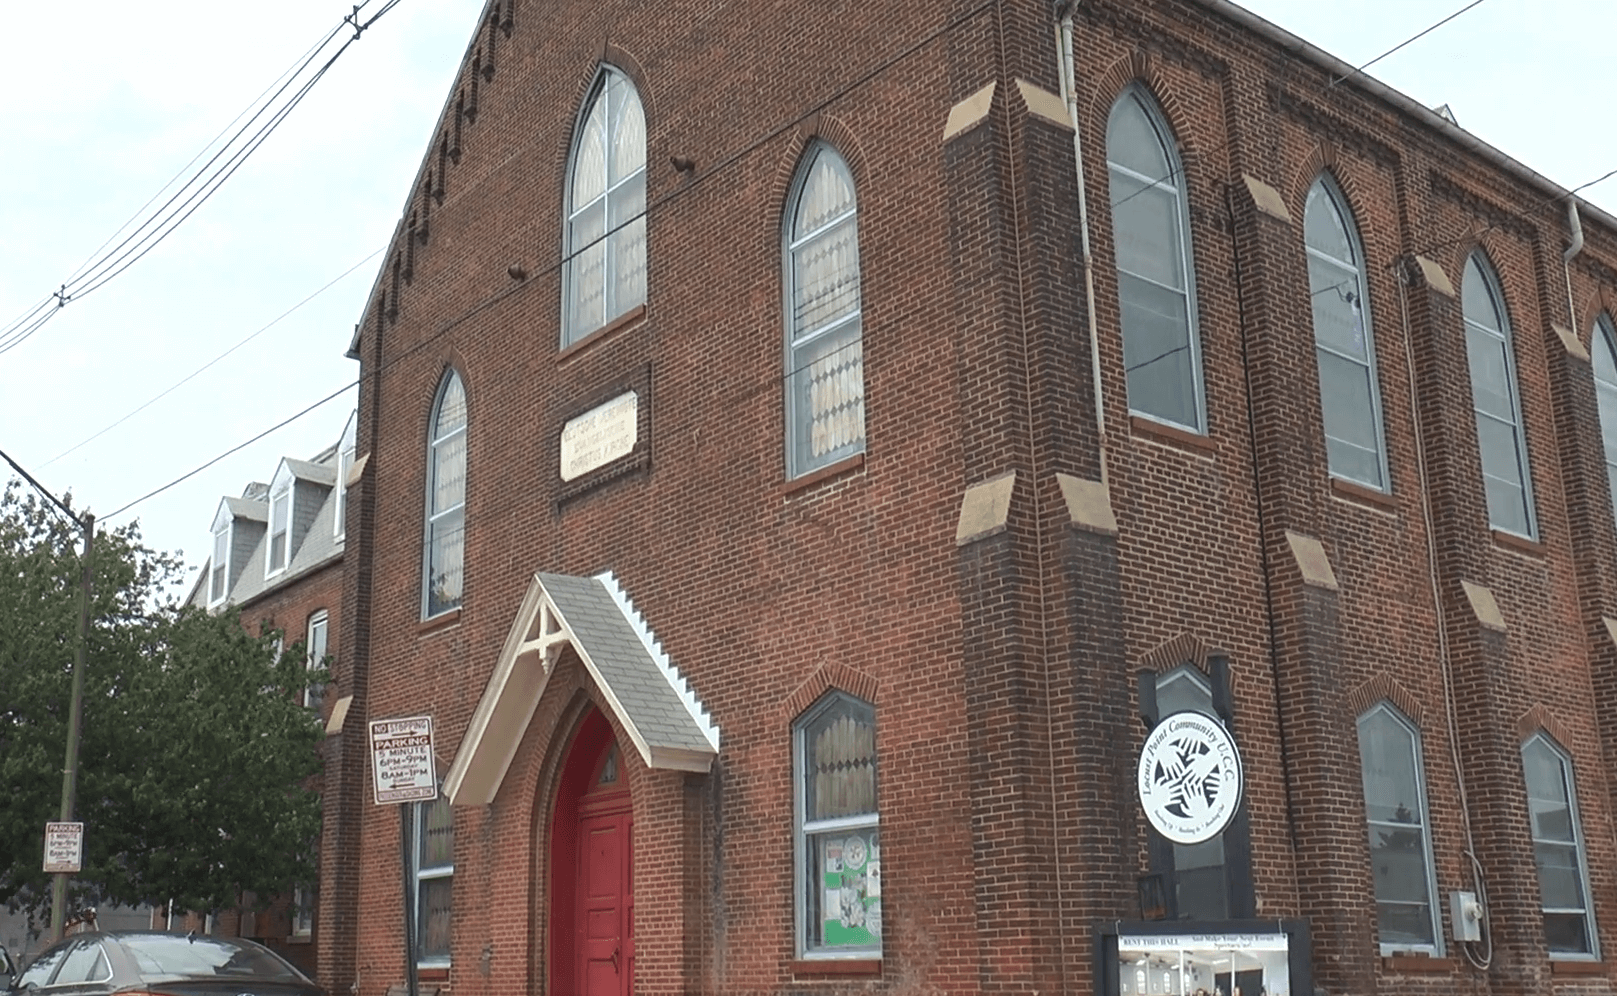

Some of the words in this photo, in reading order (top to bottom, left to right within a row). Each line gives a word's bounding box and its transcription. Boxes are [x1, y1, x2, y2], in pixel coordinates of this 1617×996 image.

[374, 725, 387, 734] NO
[389, 720, 427, 733] STOPPING
[375, 736, 429, 750] PARKING
[379, 750, 385, 758] 5
[389, 747, 426, 756] MINUTE
[1143, 758, 1152, 794] Locust
[1148, 729, 1167, 757] Point
[1169, 720, 1218, 743] Community
